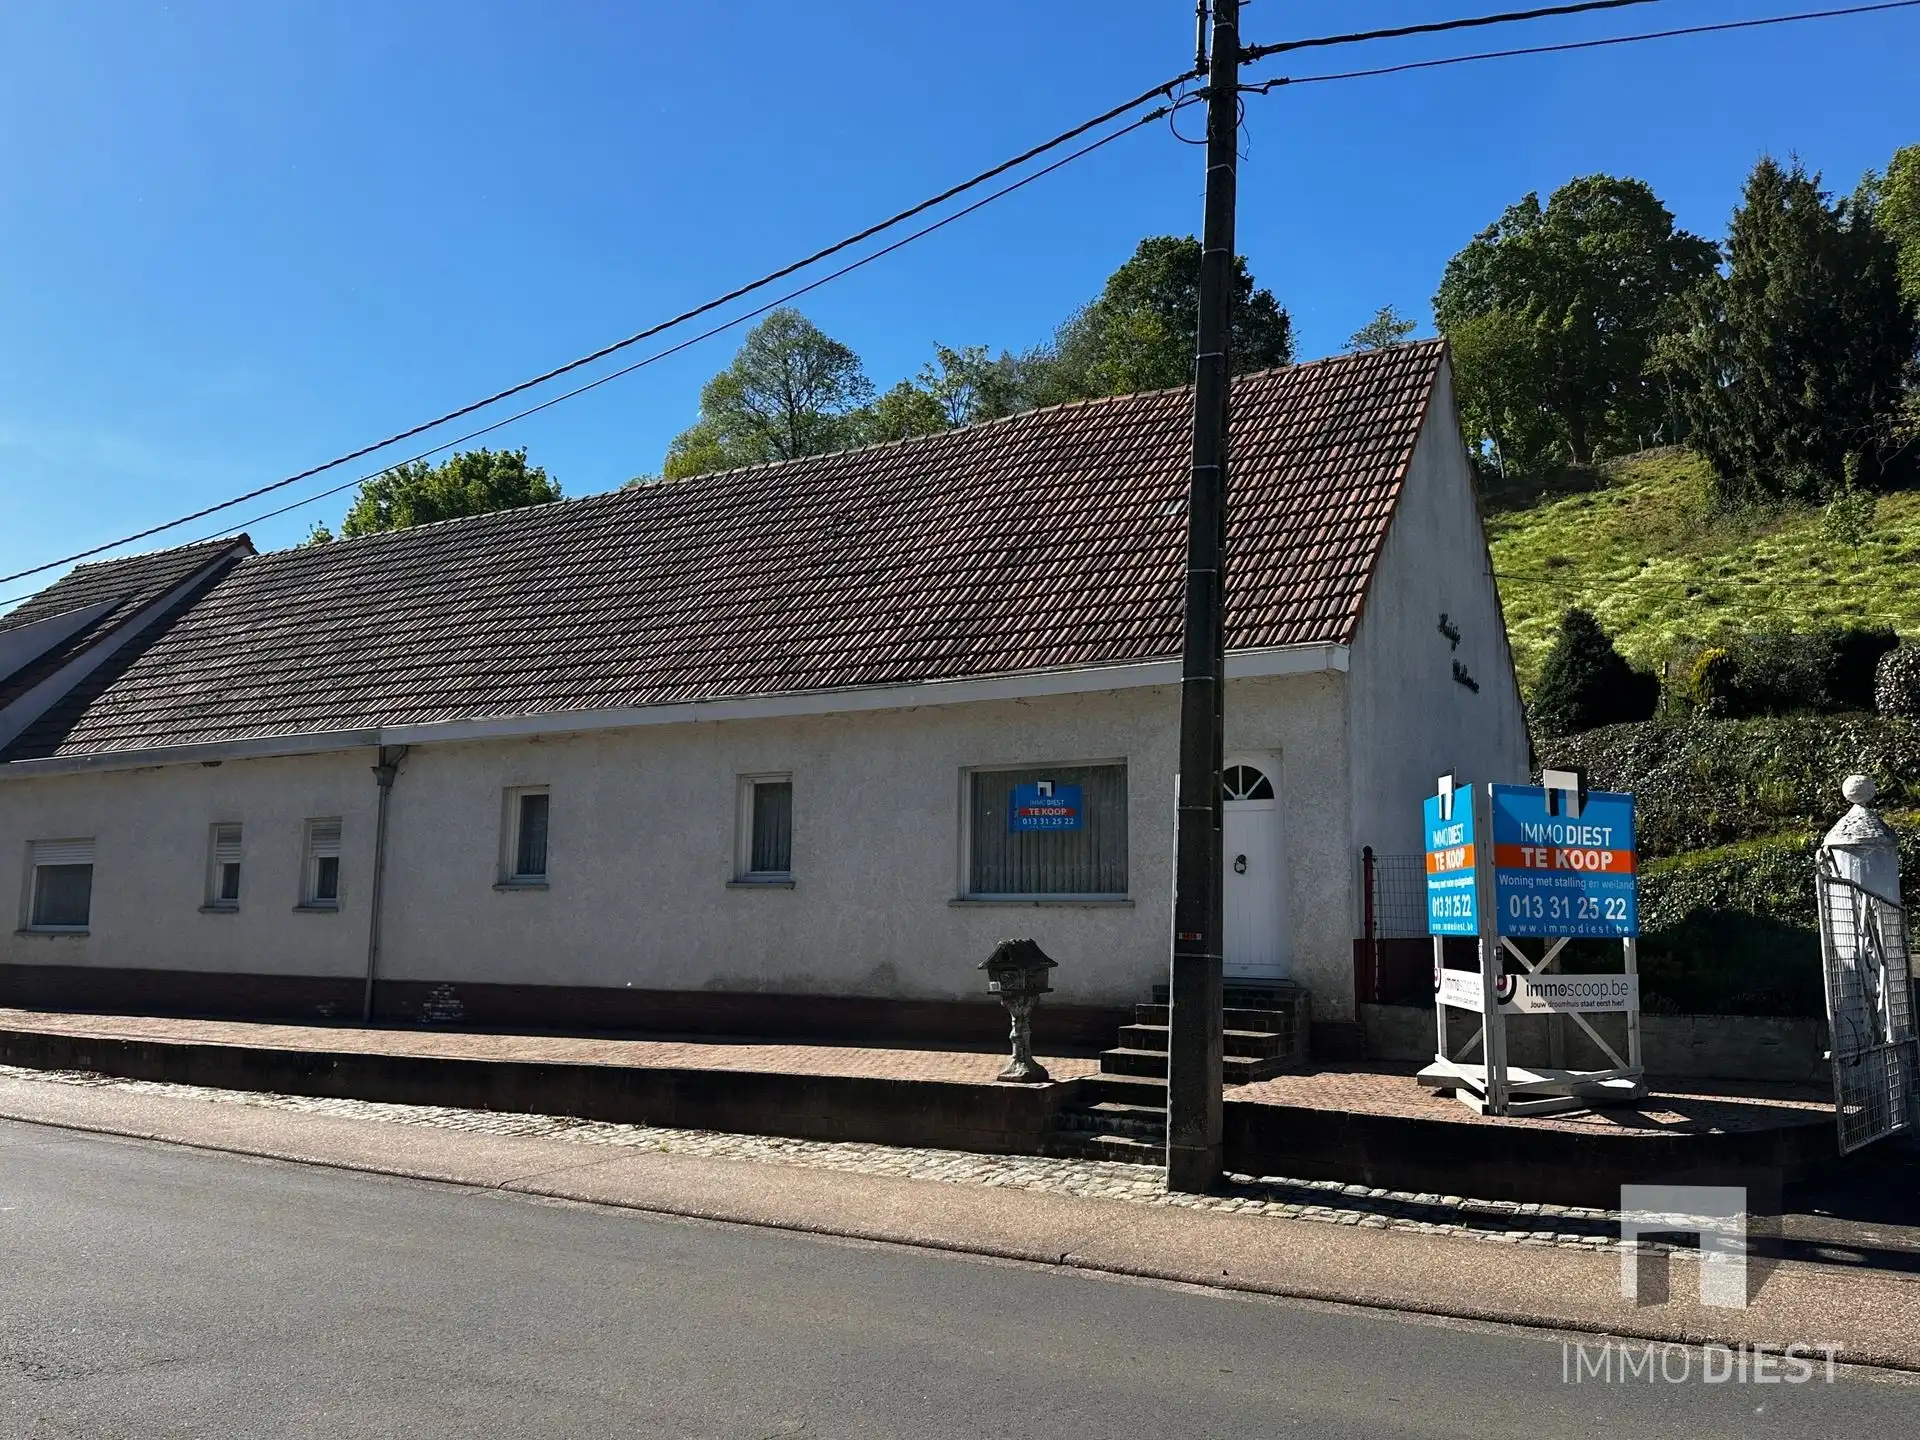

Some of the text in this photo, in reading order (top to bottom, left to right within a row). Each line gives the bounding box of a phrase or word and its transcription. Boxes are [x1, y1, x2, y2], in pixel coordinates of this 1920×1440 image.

[1028, 807, 1067, 816] TE KOOP
[1520, 822, 1612, 847] IMMO DIEST
[1434, 847, 1465, 871] TE KOOP
[1521, 848, 1613, 871] TE KOOP
[1499, 874, 1634, 890] Woning met stalling en weiland
[1432, 894, 1472, 918] 013 31 25 22
[1509, 894, 1627, 920] 013 31 25 22
[1509, 924, 1629, 934] www.immodiest.be
[1526, 979, 1629, 1000] immoscoop.be
[1530, 1001, 1546, 1009] Jouw
[1548, 1000, 1580, 1008] droomhuis
